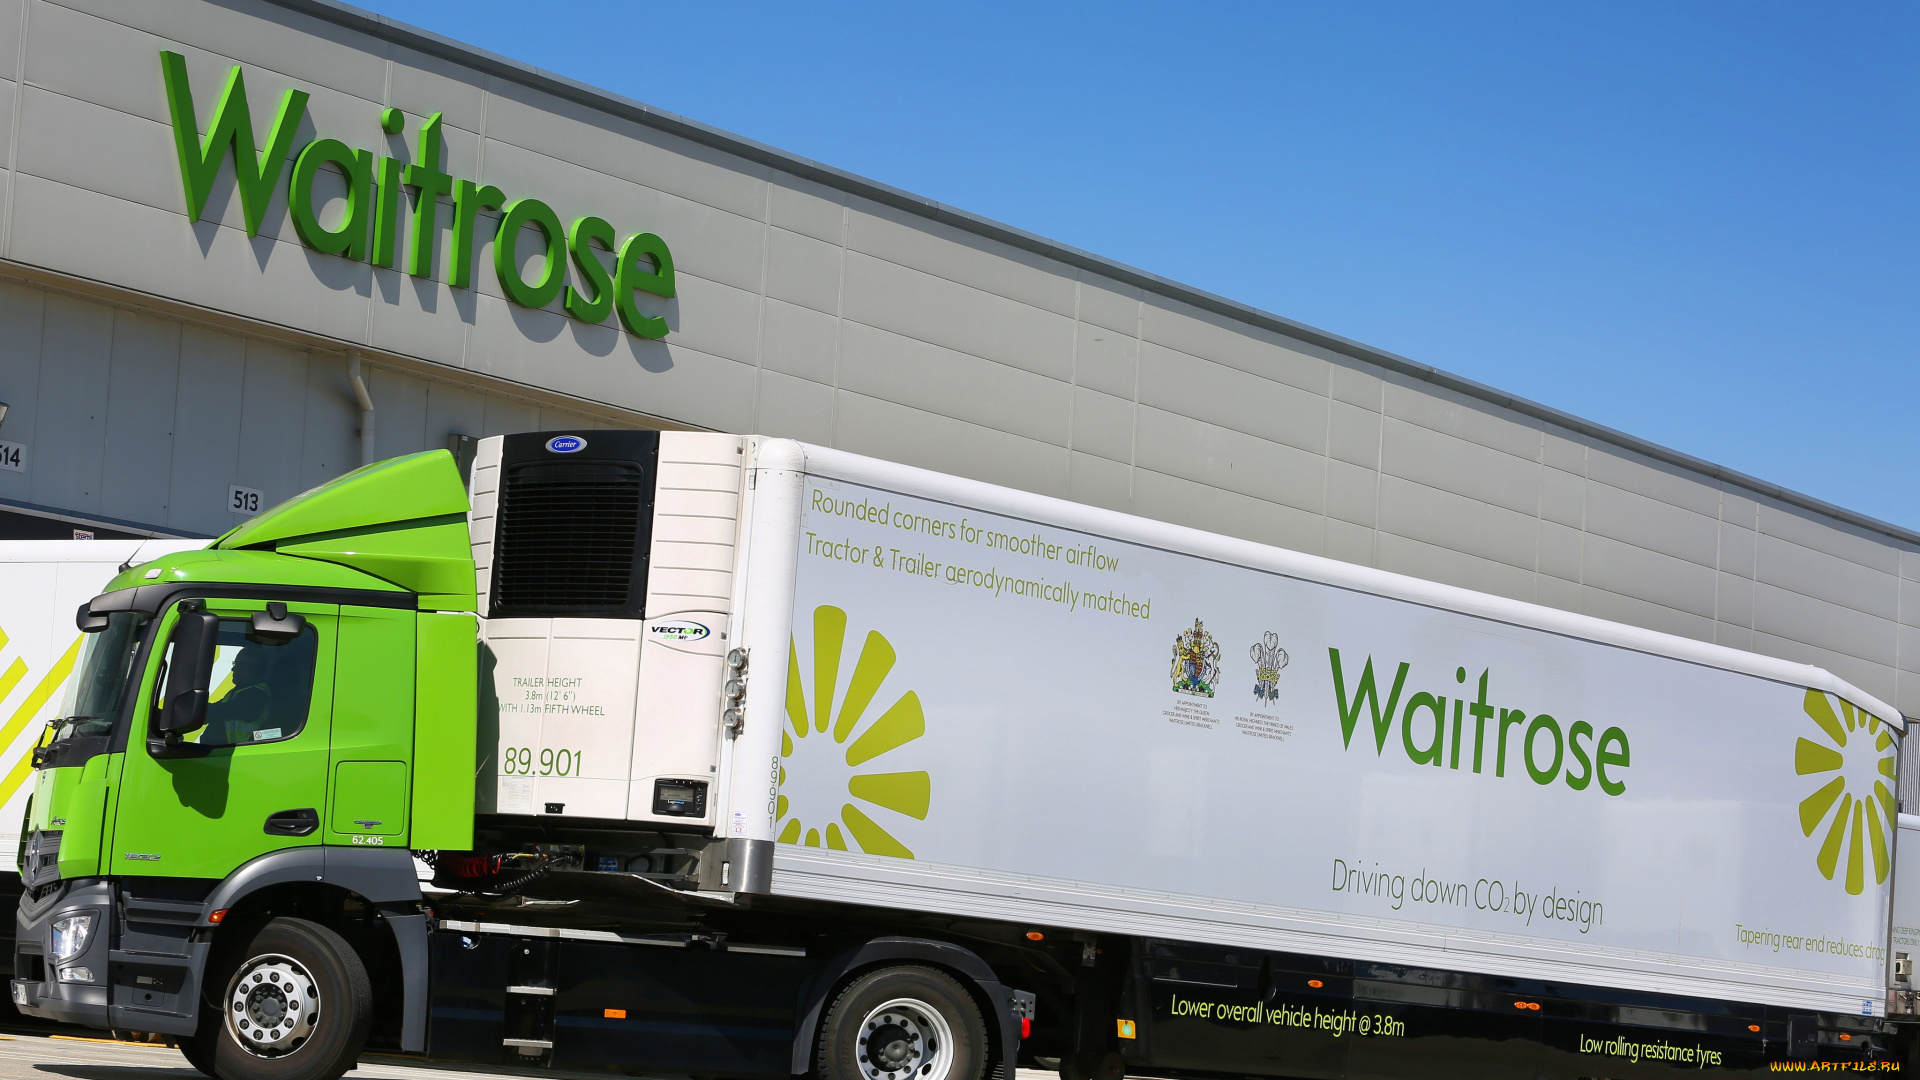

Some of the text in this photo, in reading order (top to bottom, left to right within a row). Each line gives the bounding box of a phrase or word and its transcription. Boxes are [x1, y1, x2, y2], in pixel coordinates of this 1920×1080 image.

[160, 50, 676, 340] Waitrose
[554, 441, 577, 449] Carrier
[233, 490, 259, 512] 513
[811, 488, 1119, 572] Rounded corners for smoother airflow
[806, 531, 1151, 620] Tractor & Trailer aerodynamically matched
[651, 626, 704, 635] VECTOR
[513, 677, 583, 688] TRAILER HEIGHT
[525, 690, 543, 700] 3.8m
[520, 703, 542, 714] 1.13m
[544, 704, 570, 715] FIFTH
[571, 705, 605, 716] WHEEL
[1328, 646, 1631, 797] Waitrose
[503, 747, 582, 777] 89.901
[767, 756, 779, 829] 89.901
[352, 835, 384, 846] 62.405
[1332, 858, 1405, 910] Driving
[1411, 867, 1468, 908] down
[1513, 880, 1538, 927] by
[1542, 885, 1603, 934] design
[1735, 923, 1885, 967] Tapering rear end reduces drag
[1171, 994, 1405, 1037] Lower overall vehicle height @ 3.8m
[1580, 1033, 1722, 1069] Low rolling resistance tyres
